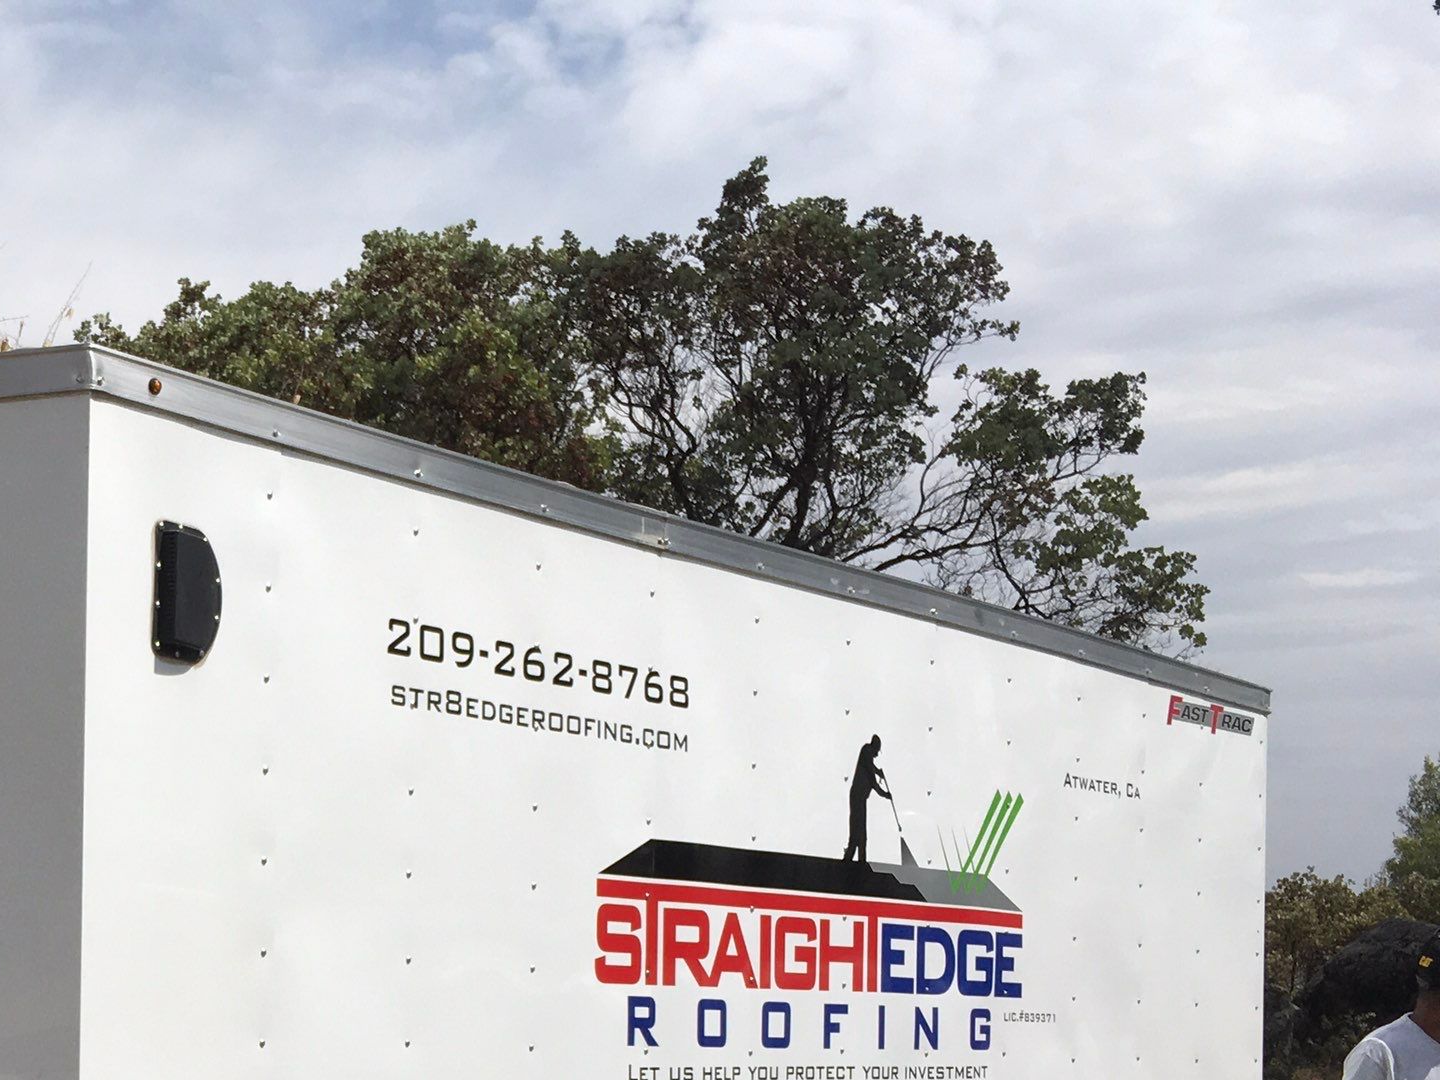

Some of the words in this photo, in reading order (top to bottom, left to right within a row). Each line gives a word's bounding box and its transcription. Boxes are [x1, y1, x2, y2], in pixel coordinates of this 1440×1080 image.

[387, 618, 689, 709] 209-262-8768
[391, 684, 688, 752] STR8EDGEROOFING.COM
[627, 996, 991, 1050] ROOFING
[748, 1066, 779, 1080] YOU
[786, 1066, 855, 1080] PROTECT
[862, 1065, 899, 1080] YOUR
[904, 1065, 988, 1080] INVESTMENT
